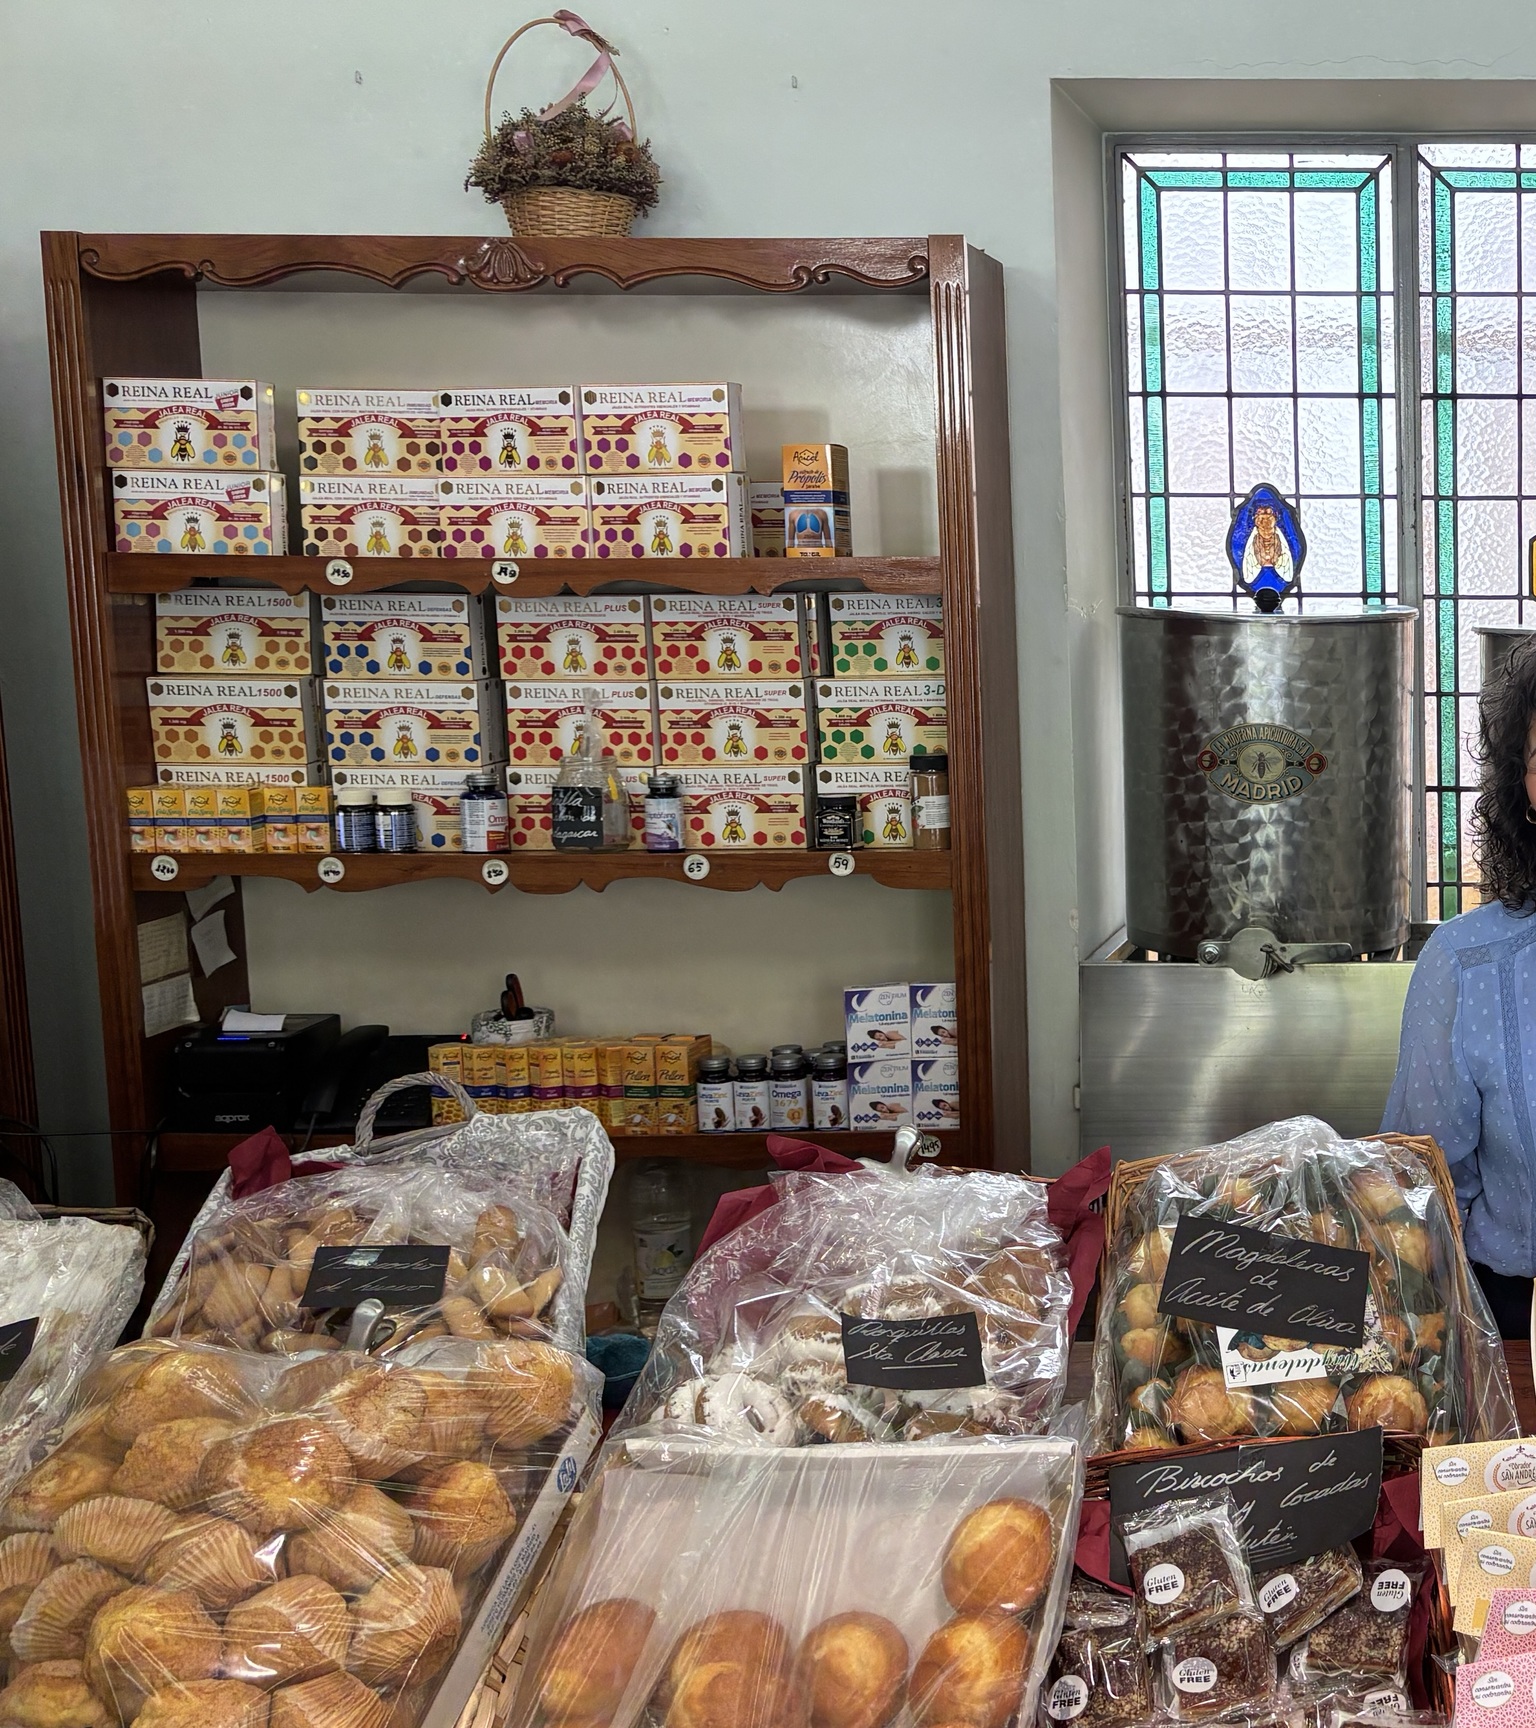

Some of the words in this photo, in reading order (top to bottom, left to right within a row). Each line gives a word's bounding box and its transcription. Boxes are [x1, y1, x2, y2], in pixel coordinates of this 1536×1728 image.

[121, 385, 169, 397] REINA
[173, 387, 213, 399] REAL
[599, 392, 644, 404] REINA
[647, 391, 687, 403] REAL
[454, 394, 496, 406] REINA
[499, 394, 535, 406] REAL
[158, 406, 185, 419] JALEA
[186, 406, 207, 419] REAL
[130, 477, 179, 489] REINA
[182, 478, 224, 490] REAL
[167, 498, 194, 511] JALEA
[195, 499, 217, 511] REAL
[174, 594, 222, 607] REINA
[225, 595, 265, 607] REAL
[265, 598, 292, 607] 1500
[339, 599, 386, 611] REINA
[388, 600, 426, 612] REAL
[669, 600, 714, 611] REINA
[718, 600, 757, 611] REAL
[847, 599, 895, 610] REINA
[896, 599, 934, 610] REAL
[514, 602, 559, 613] REINA
[563, 602, 602, 613] REAL
[604, 604, 627, 612] PLUS
[165, 685, 213, 696] REINA
[217, 685, 257, 697] REAL
[257, 688, 282, 697] 1500
[835, 686, 879, 697] REINA
[884, 686, 922, 697] REAL
[203, 705, 229, 717] JALEA
[229, 705, 251, 717] REAL
[1224, 727, 1258, 749] MODERNA
[1259, 727, 1298, 748] APICULTURA
[1221, 772, 1303, 800] MADRID
[688, 862, 704, 873] 65
[833, 856, 849, 870] 59
[848, 1011, 908, 1024] Melatonina
[772, 1090, 802, 1099] Omega
[851, 1083, 910, 1095] Melatonina
[1181, 1229, 1357, 1283] Magdalenas
[1502, 1470, 1514, 1481] SAN
[1146, 1572, 1178, 1588] Gluten
[1376, 1580, 1408, 1591] FREE
[1147, 1582, 1180, 1598] FREE
[1262, 1579, 1289, 1604] Gluten
[1266, 1584, 1293, 1609] FREE
[1177, 1666, 1211, 1677] Gluten
[1179, 1674, 1211, 1684] FREE
